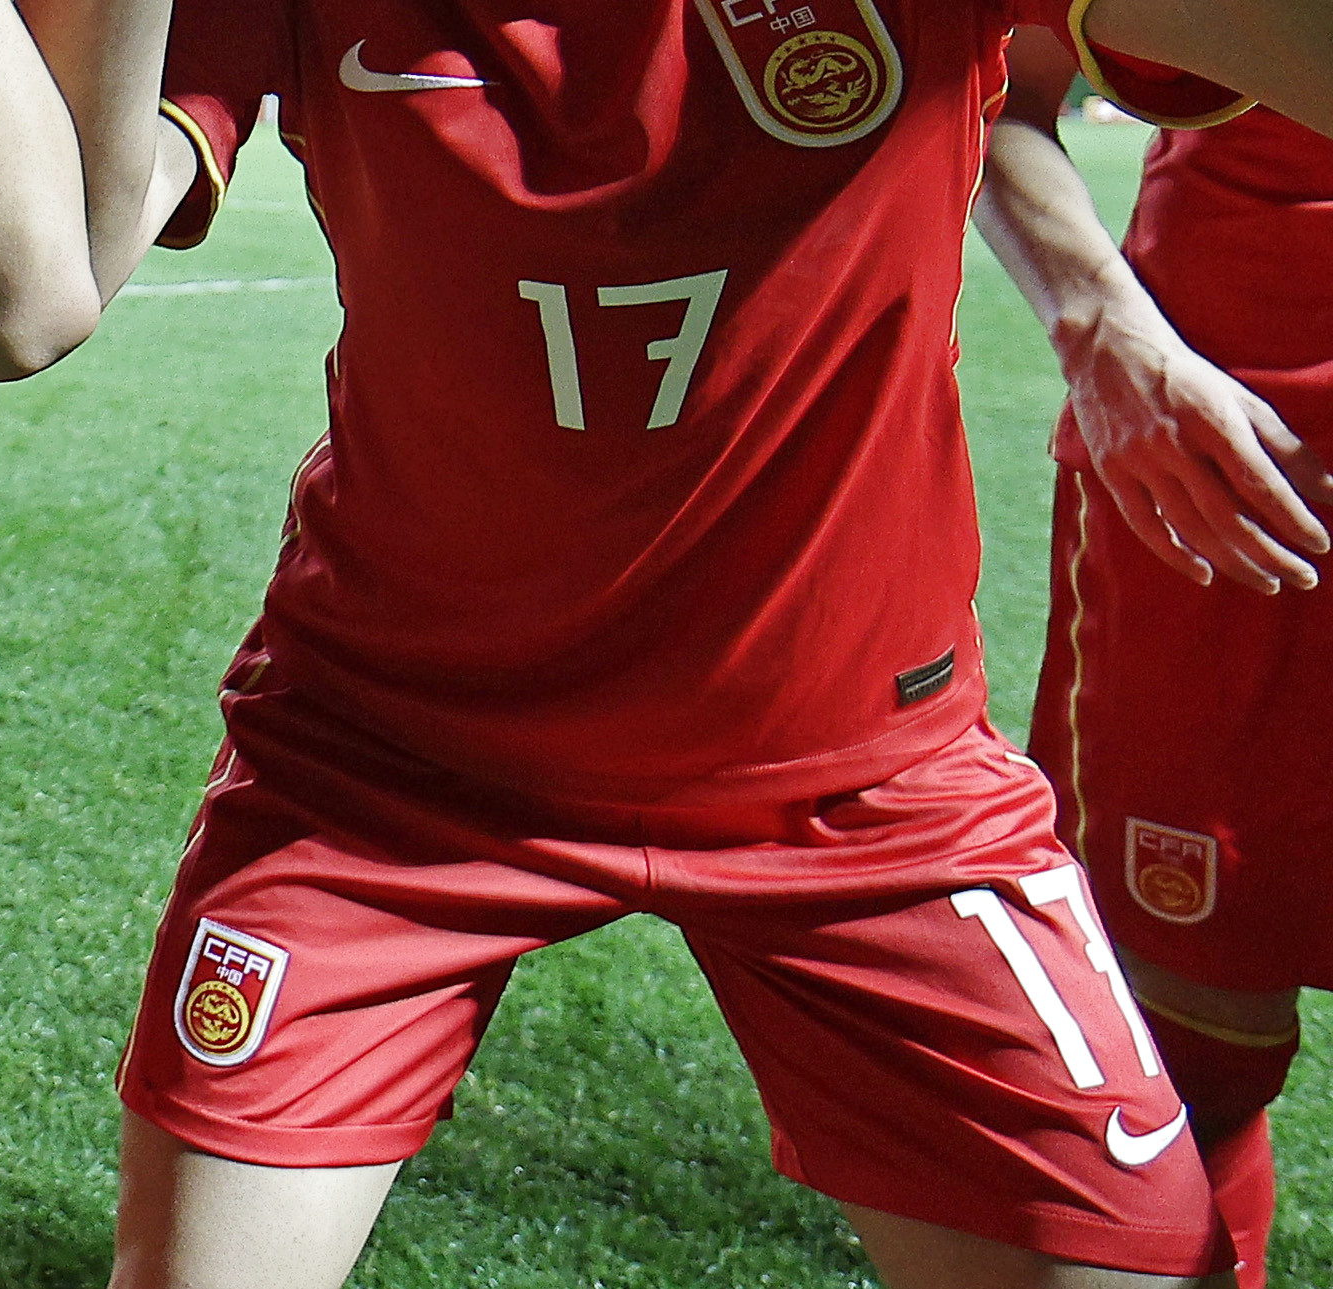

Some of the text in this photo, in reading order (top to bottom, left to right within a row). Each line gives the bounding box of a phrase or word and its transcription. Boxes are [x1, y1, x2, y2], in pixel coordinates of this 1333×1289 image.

[770, 6, 815, 34] 中国
[518, 269, 728, 430] 17
[203, 937, 272, 981] CFA
[950, 863, 1161, 1089] 17
